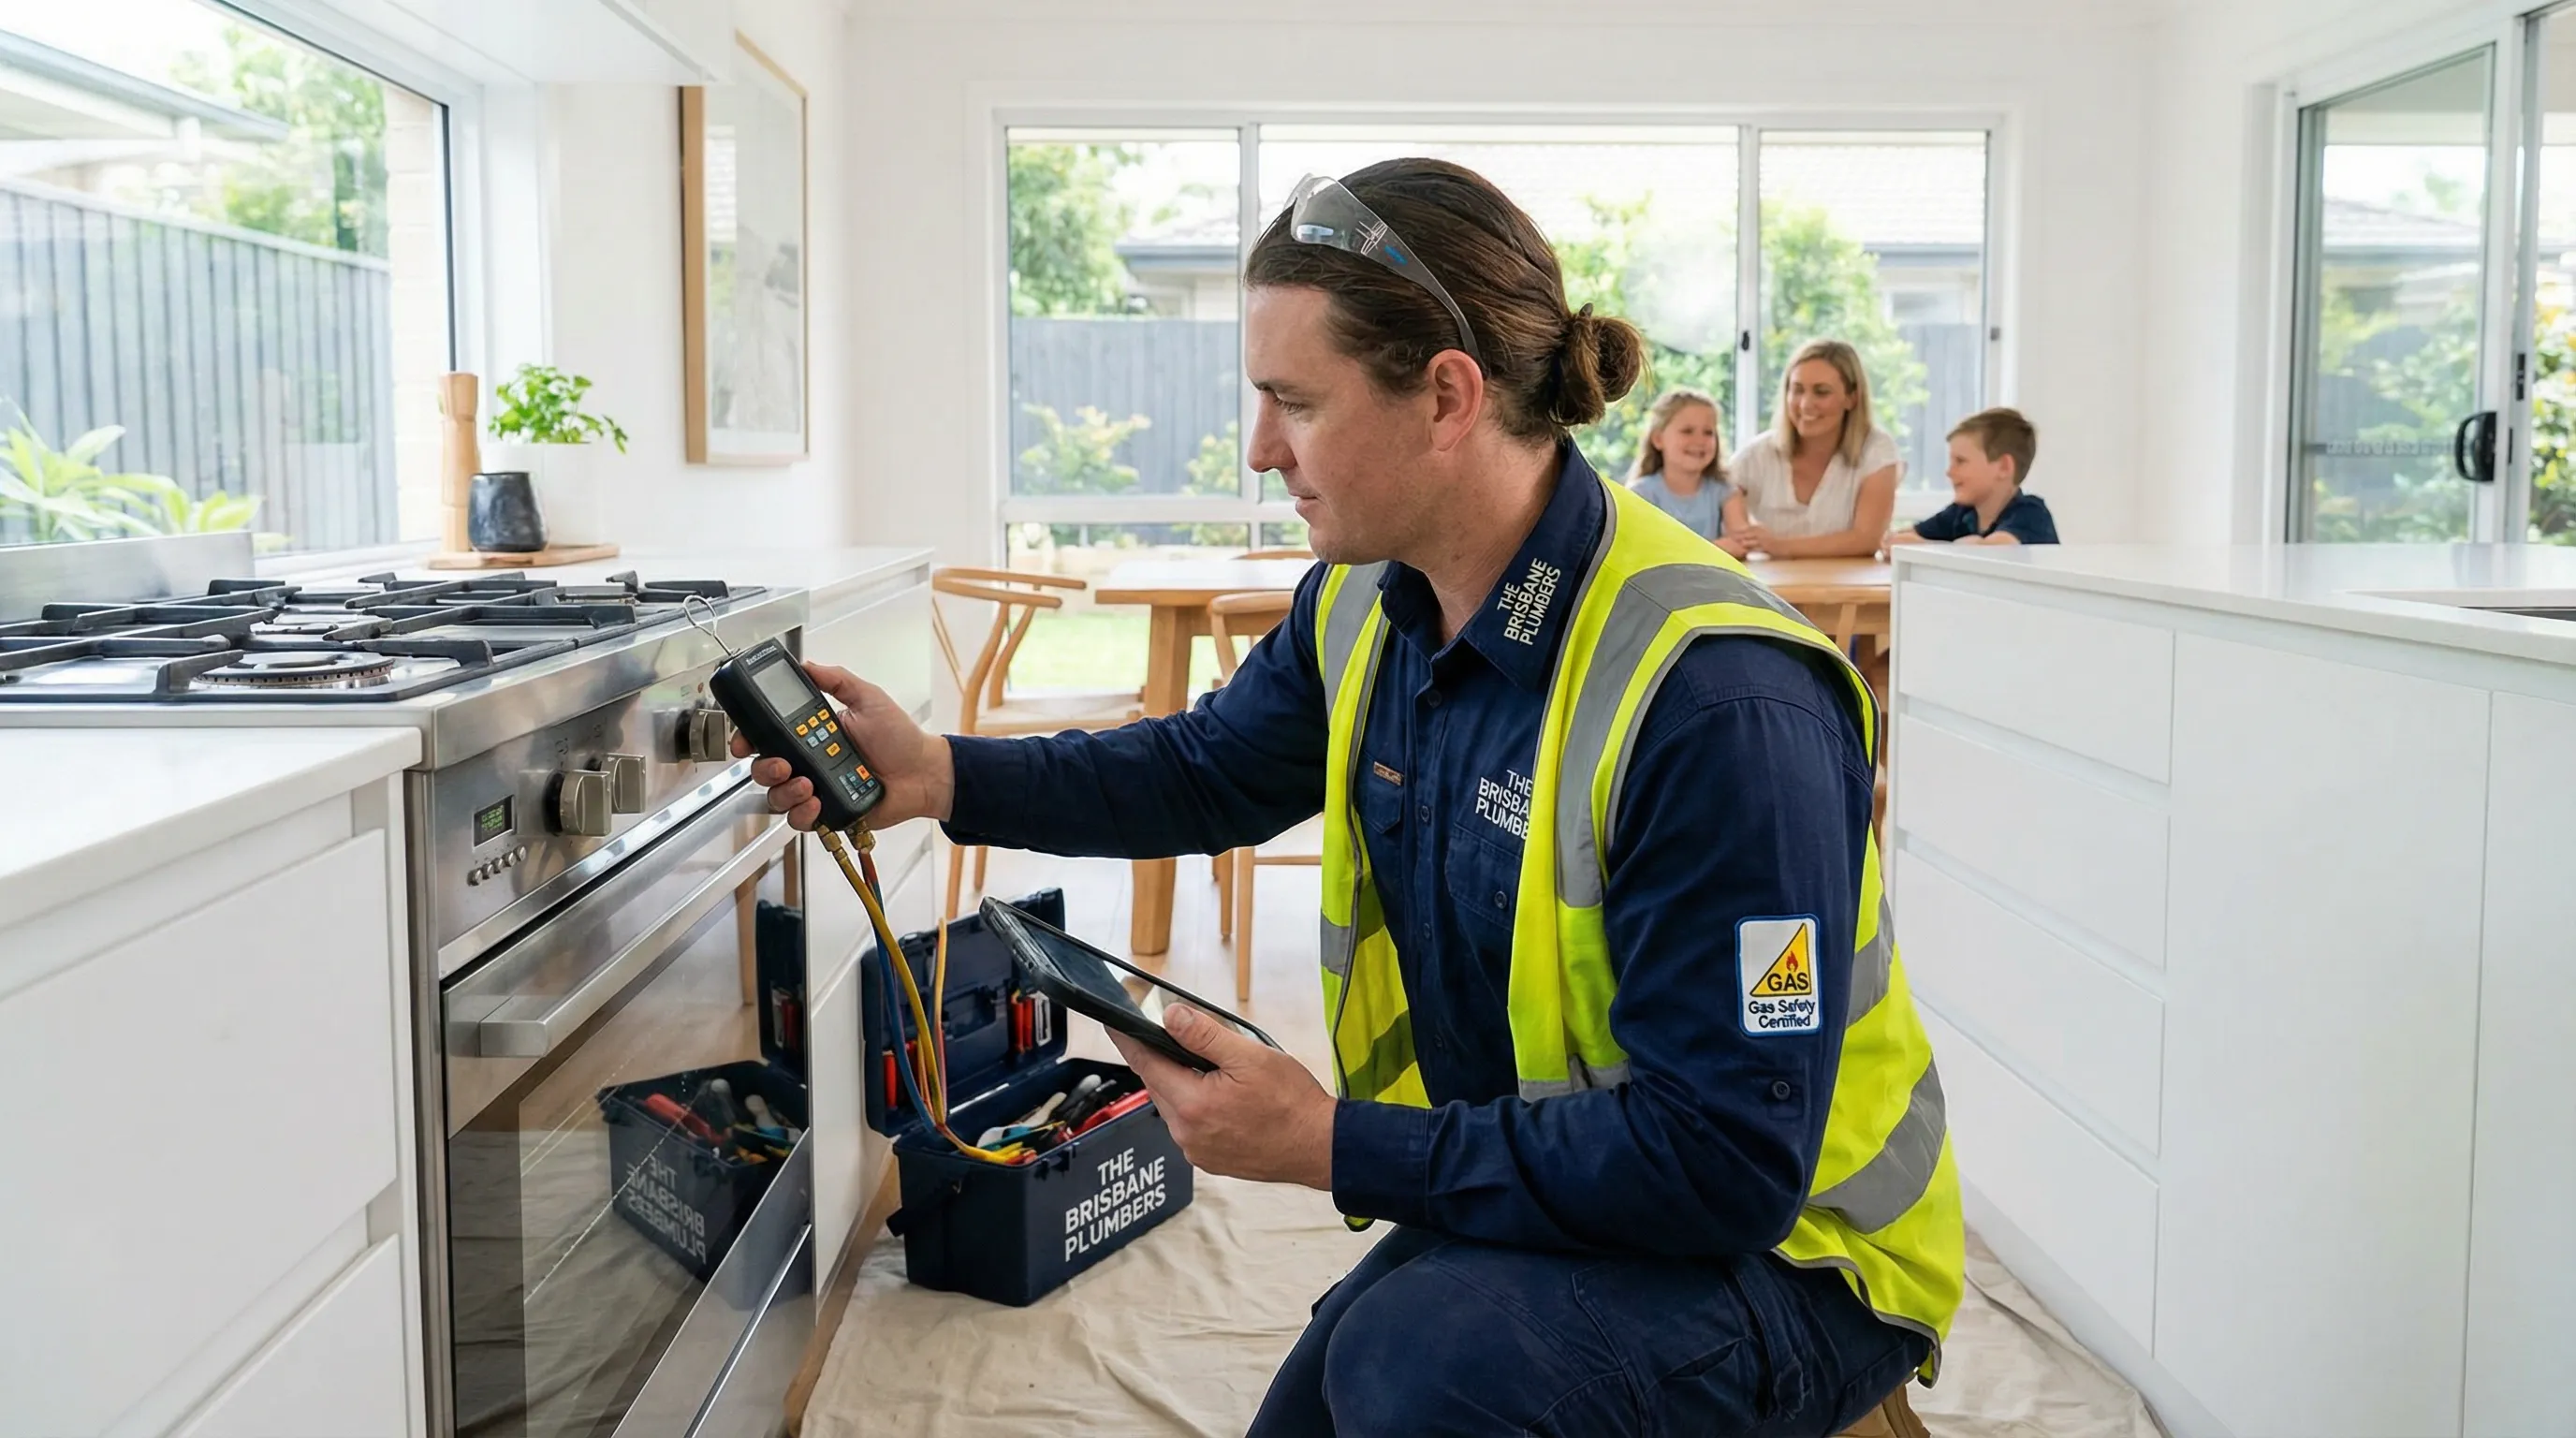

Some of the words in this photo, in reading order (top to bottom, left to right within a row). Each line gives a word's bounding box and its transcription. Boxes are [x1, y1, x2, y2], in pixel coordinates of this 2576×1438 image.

[1497, 582, 1521, 610] THE
[1503, 557, 1548, 641] BRISBANE
[1519, 566, 1561, 646] PLUMBERS
[1478, 776, 1530, 820] BRISBA
[1506, 769, 1533, 798] THE
[1475, 796, 1530, 840] PLUMBE
[1767, 972, 1809, 991] GAS
[1749, 1000, 1776, 1014] Gas
[1097, 1147, 1134, 1186] THE
[1065, 1155, 1165, 1235] BRISBANE
[1065, 1182, 1166, 1263] PLUMBERS
